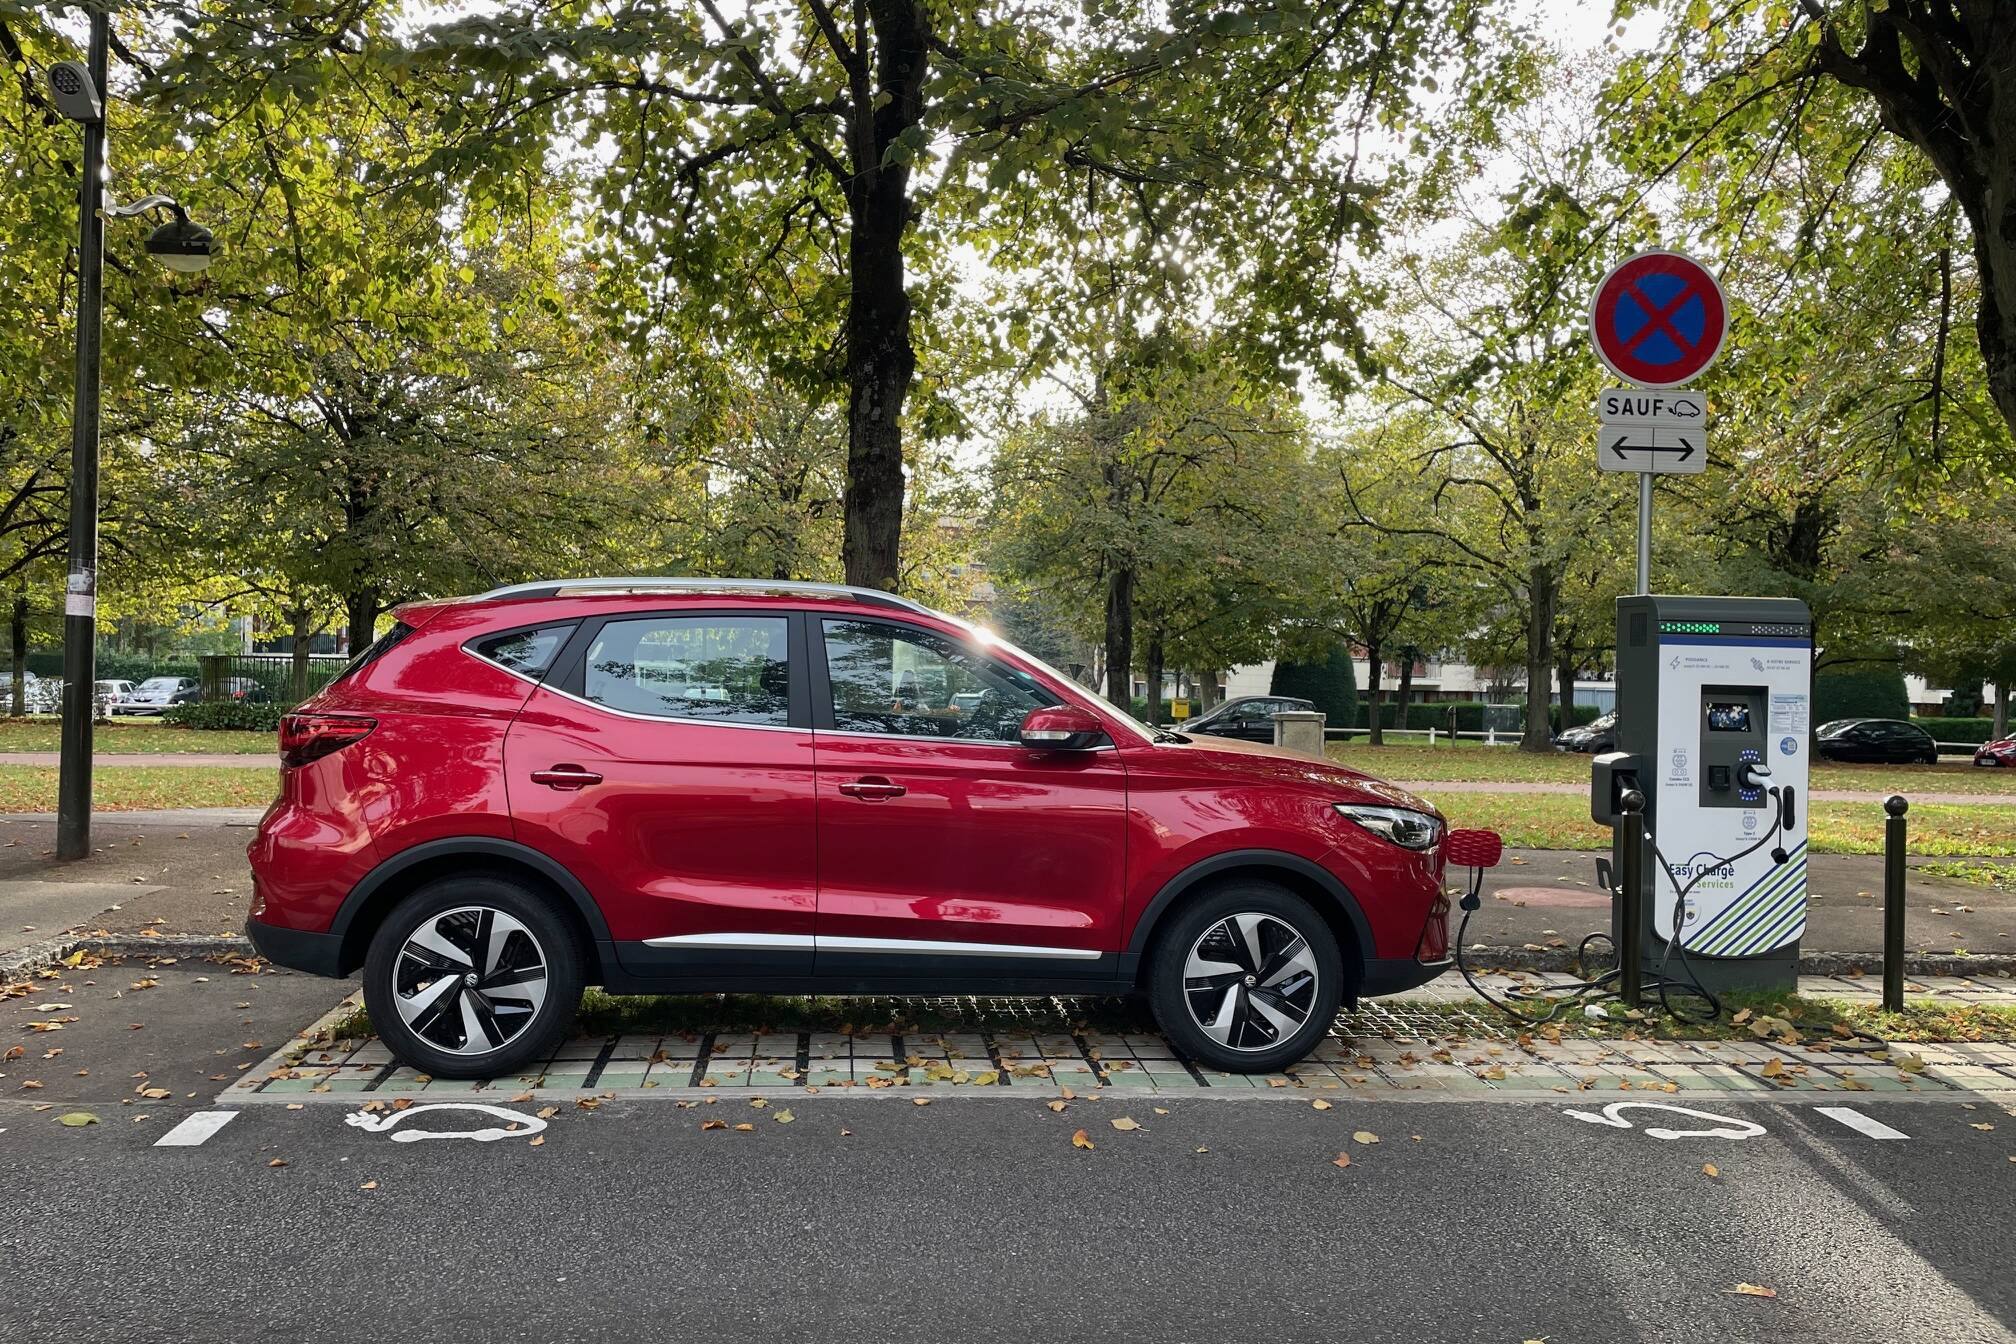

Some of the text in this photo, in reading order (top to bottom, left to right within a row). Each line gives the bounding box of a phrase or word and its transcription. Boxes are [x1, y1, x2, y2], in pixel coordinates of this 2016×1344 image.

[1607, 398, 1664, 416] SAUF
[1670, 864, 1693, 879] Easy
[1697, 879, 1734, 888] Services
